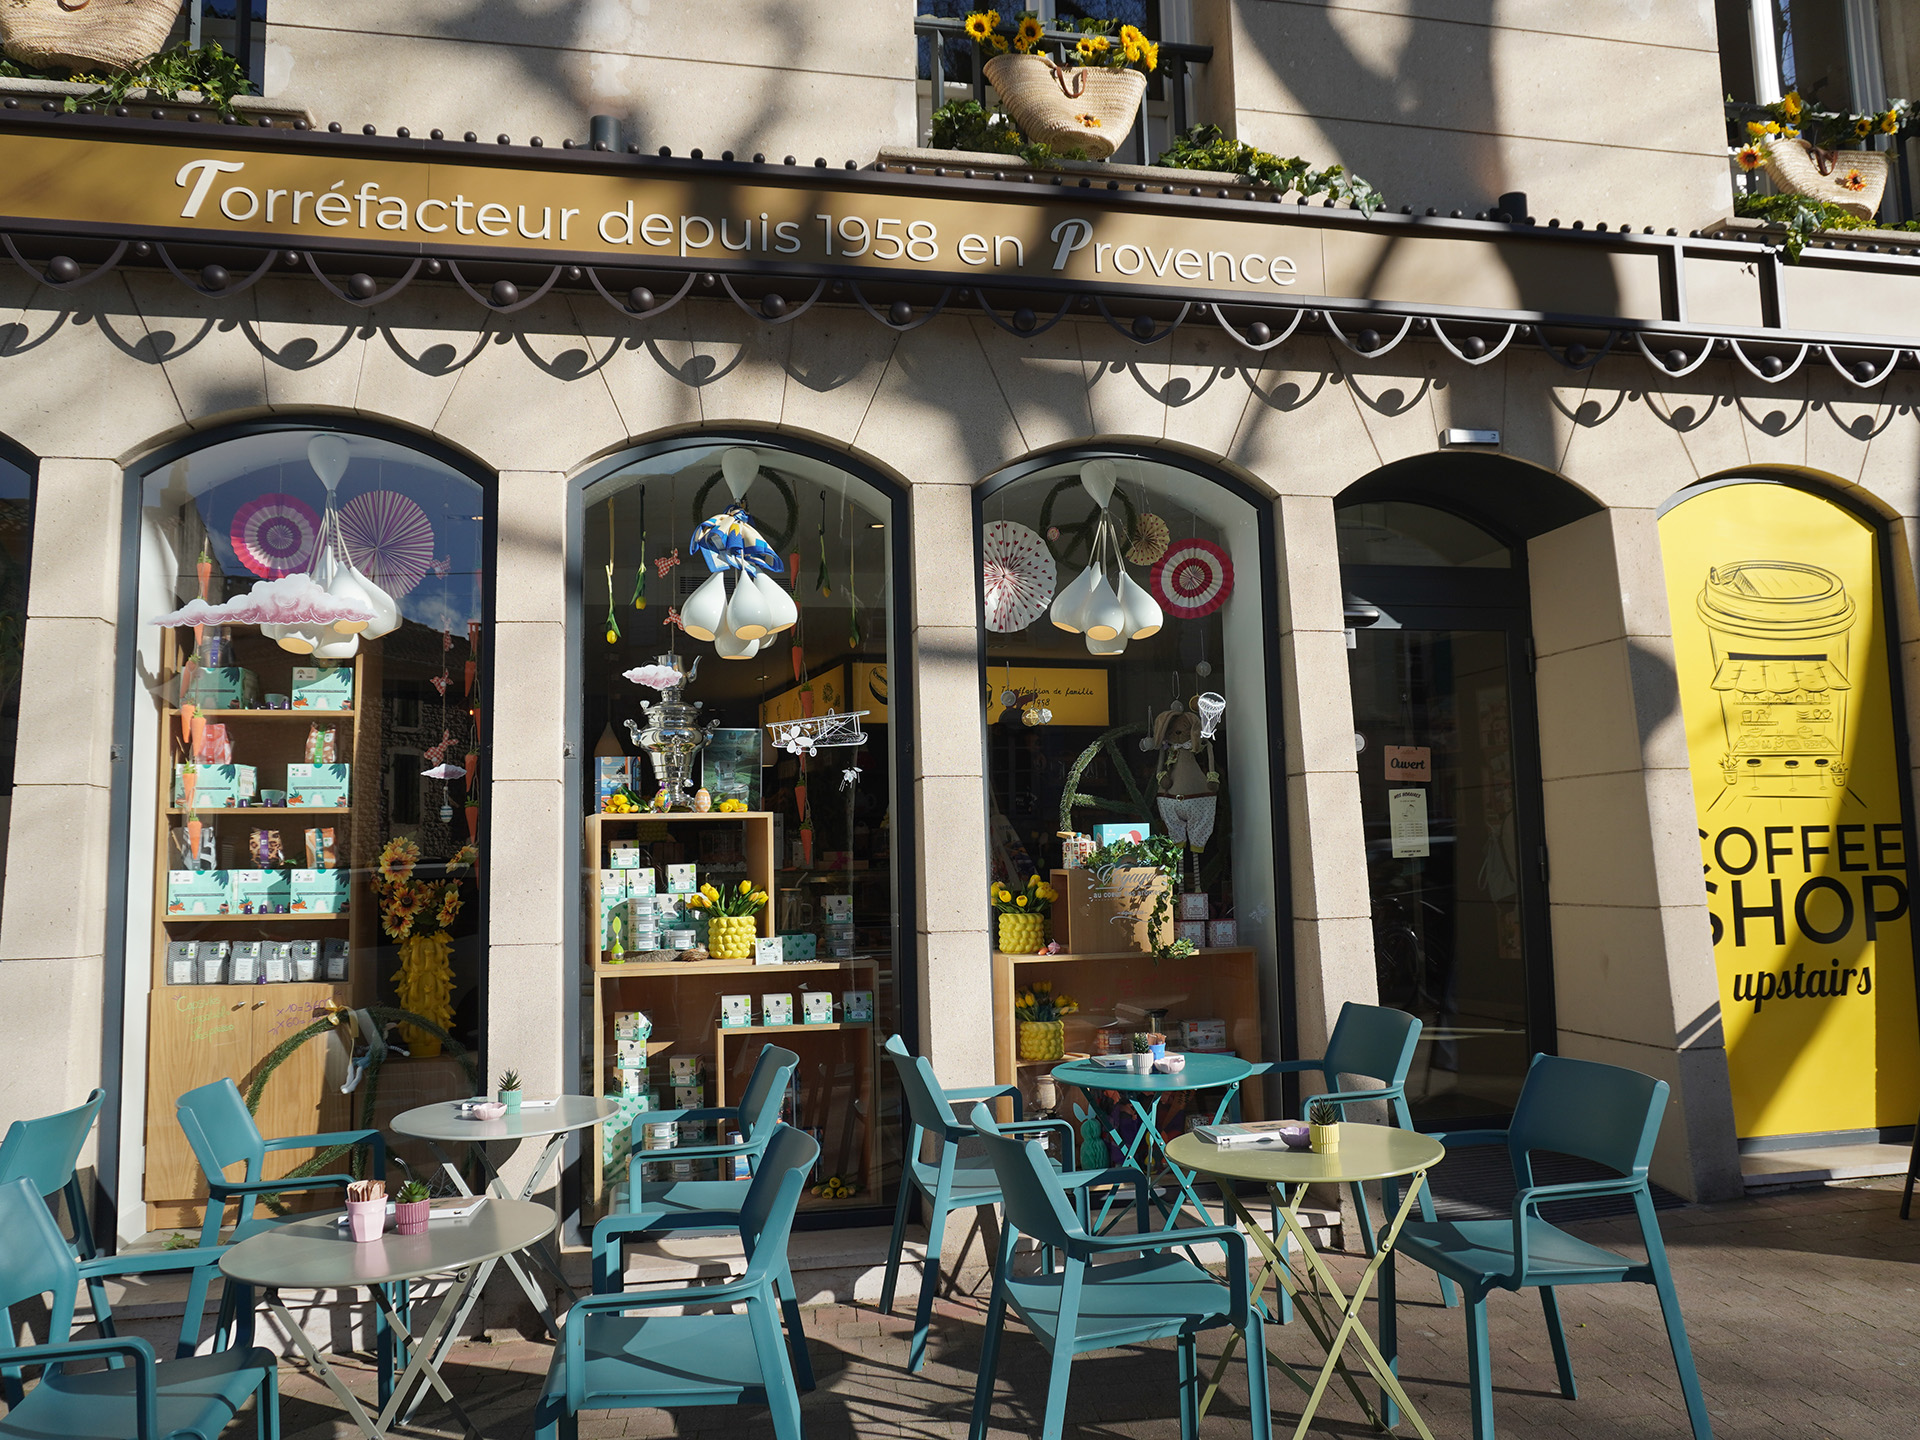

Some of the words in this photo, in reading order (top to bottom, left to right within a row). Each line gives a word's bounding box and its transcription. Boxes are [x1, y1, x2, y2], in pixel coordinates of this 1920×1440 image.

[175, 158, 580, 241] Torréfacteur
[597, 199, 801, 258] depuis
[816, 213, 940, 263] 1958
[957, 233, 1024, 267] en
[1050, 218, 1298, 287] Provence
[1390, 757, 1426, 770] Ouvert
[1733, 958, 1872, 1014] upstairs
